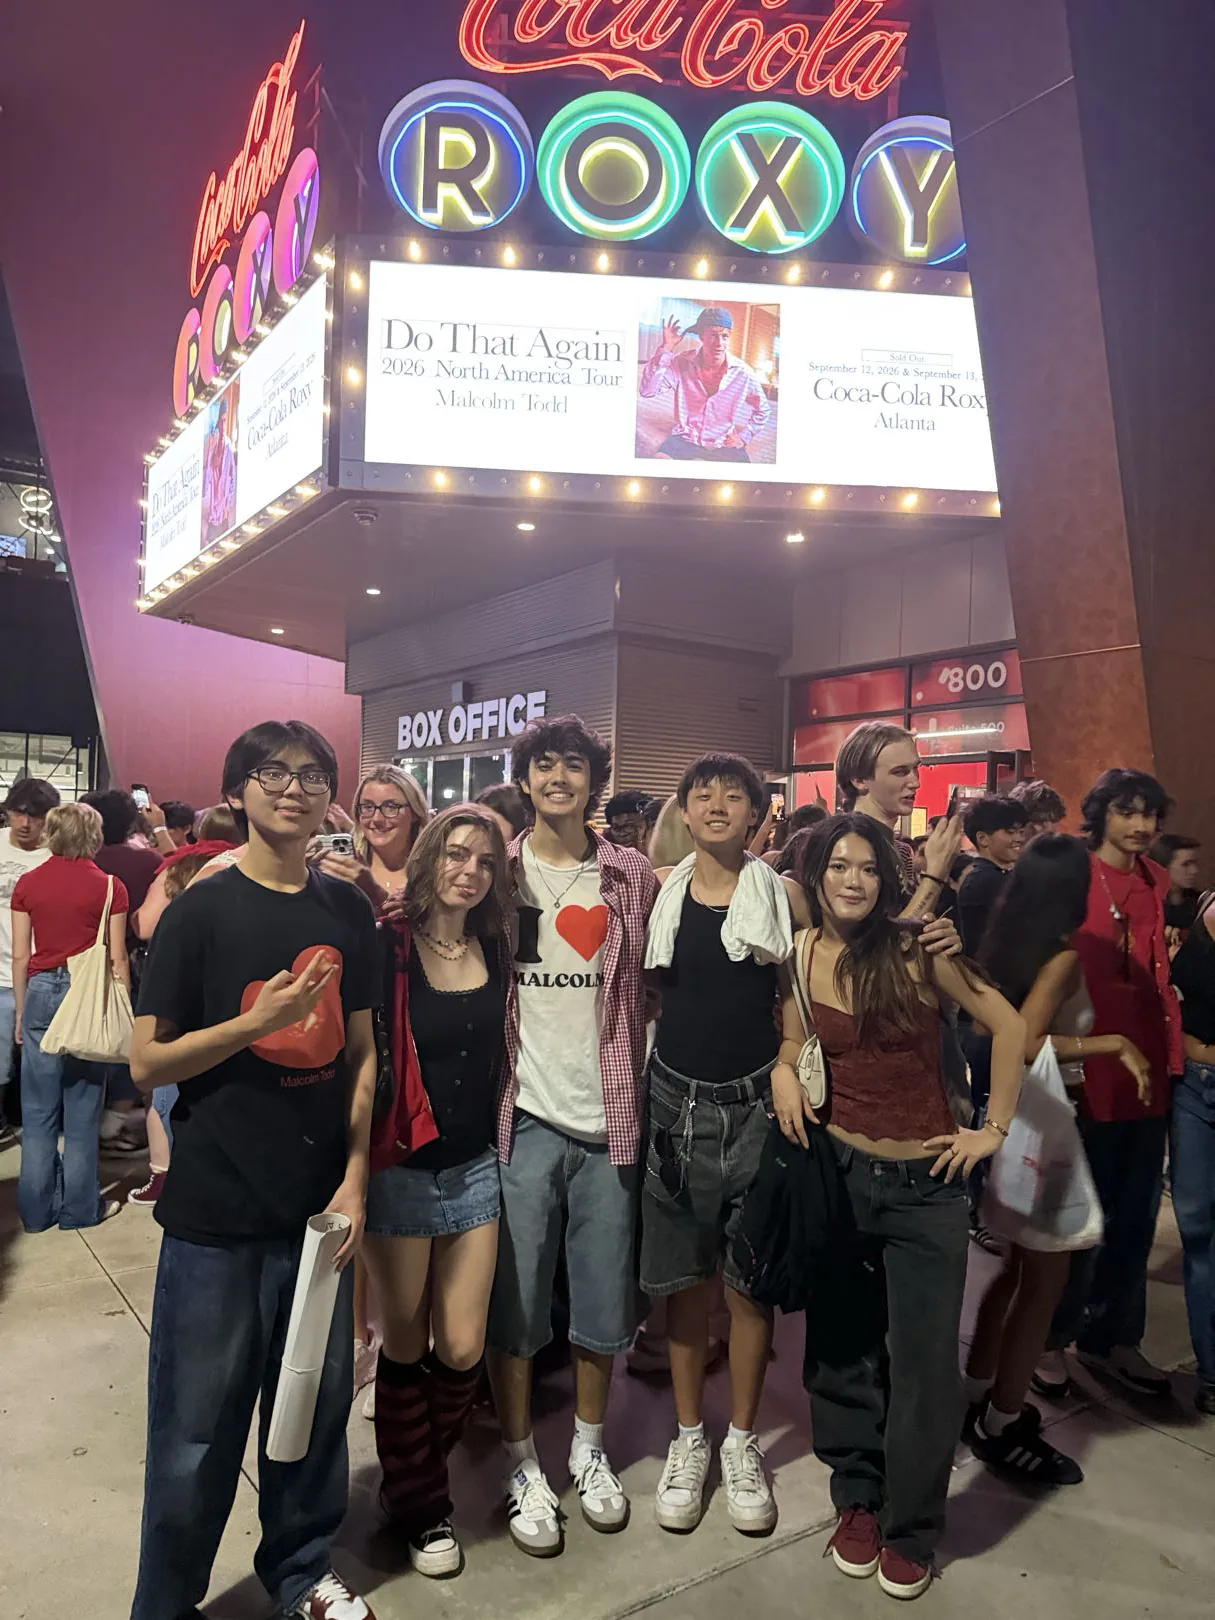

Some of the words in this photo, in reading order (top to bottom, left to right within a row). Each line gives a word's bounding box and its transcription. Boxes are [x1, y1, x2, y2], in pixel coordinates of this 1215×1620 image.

[418, 109, 956, 256] ROXY
[384, 318, 433, 352] Do
[440, 322, 519, 357] That
[526, 328, 623, 370] Again
[889, 352, 907, 363] Sold
[909, 353, 925, 363] Out
[382, 357, 425, 377] 2026
[434, 359, 490, 380] North
[494, 363, 572, 384] America
[581, 367, 624, 387] Tour
[808, 361, 857, 374] September
[861, 364, 874, 376] 12,
[877, 366, 900, 376] 2026
[902, 368, 910, 377] &
[913, 367, 961, 381] September
[435, 388, 515, 410] Malcolm
[521, 393, 567, 413] Todd
[813, 377, 932, 407] Coca-Cola
[938, 384, 988, 410] Rox
[873, 411, 936, 431] Atlanta
[947, 661, 1007, 693] 800
[397, 709, 444, 751] BOX
[448, 690, 547, 745] OFFICE
[514, 905, 544, 964] I
[280, 1072, 320, 1088] Malcolm
